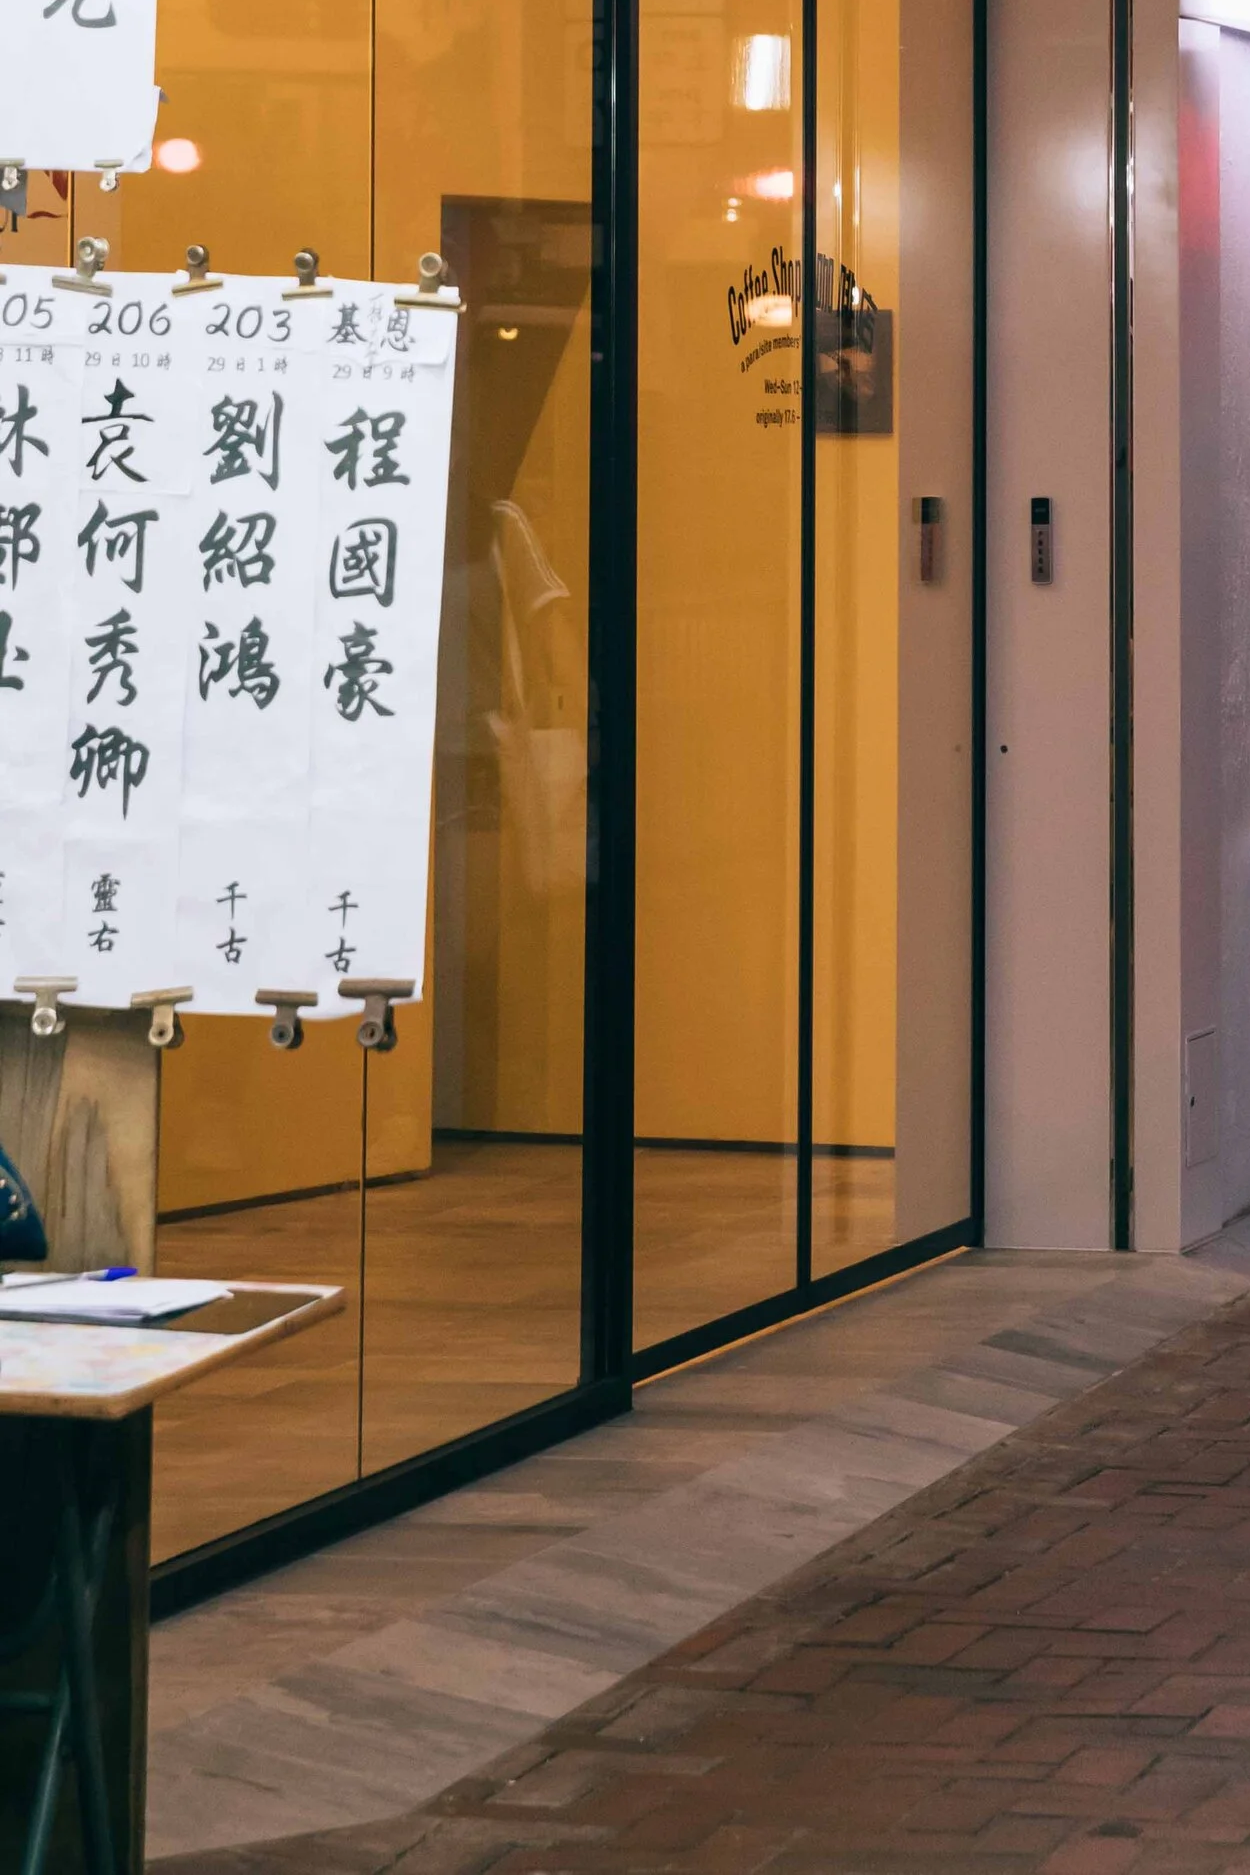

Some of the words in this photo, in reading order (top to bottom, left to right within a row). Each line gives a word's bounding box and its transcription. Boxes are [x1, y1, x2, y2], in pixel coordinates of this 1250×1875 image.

[88, 301, 171, 336] 206
[205, 303, 291, 342] 203
[215, 880, 248, 965] 千古
[325, 889, 359, 974] 千古
